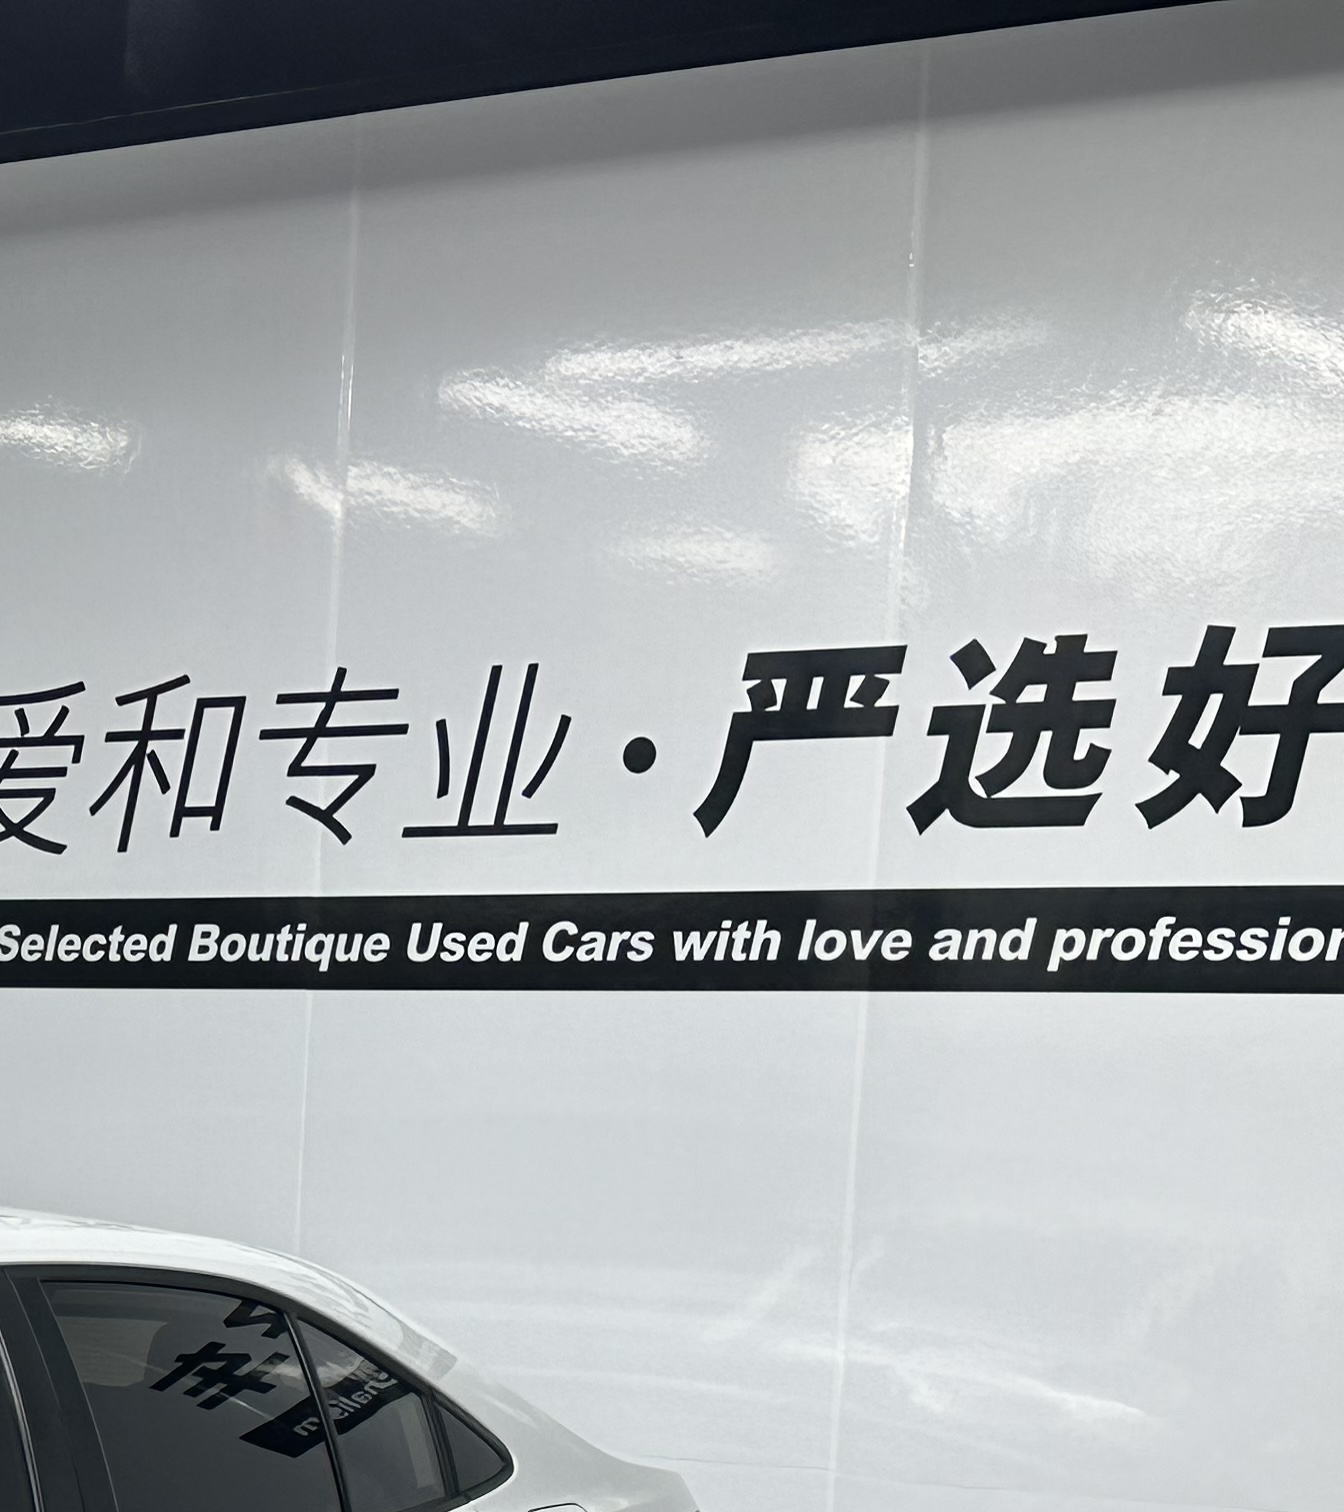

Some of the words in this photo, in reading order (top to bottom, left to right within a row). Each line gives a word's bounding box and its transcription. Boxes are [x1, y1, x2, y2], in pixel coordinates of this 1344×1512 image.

[188, 923, 390, 971] Boutique
[407, 922, 529, 962] Used
[543, 921, 654, 961] Cars
[673, 920, 781, 961] with
[798, 919, 912, 961] love
[929, 918, 1035, 961] and
